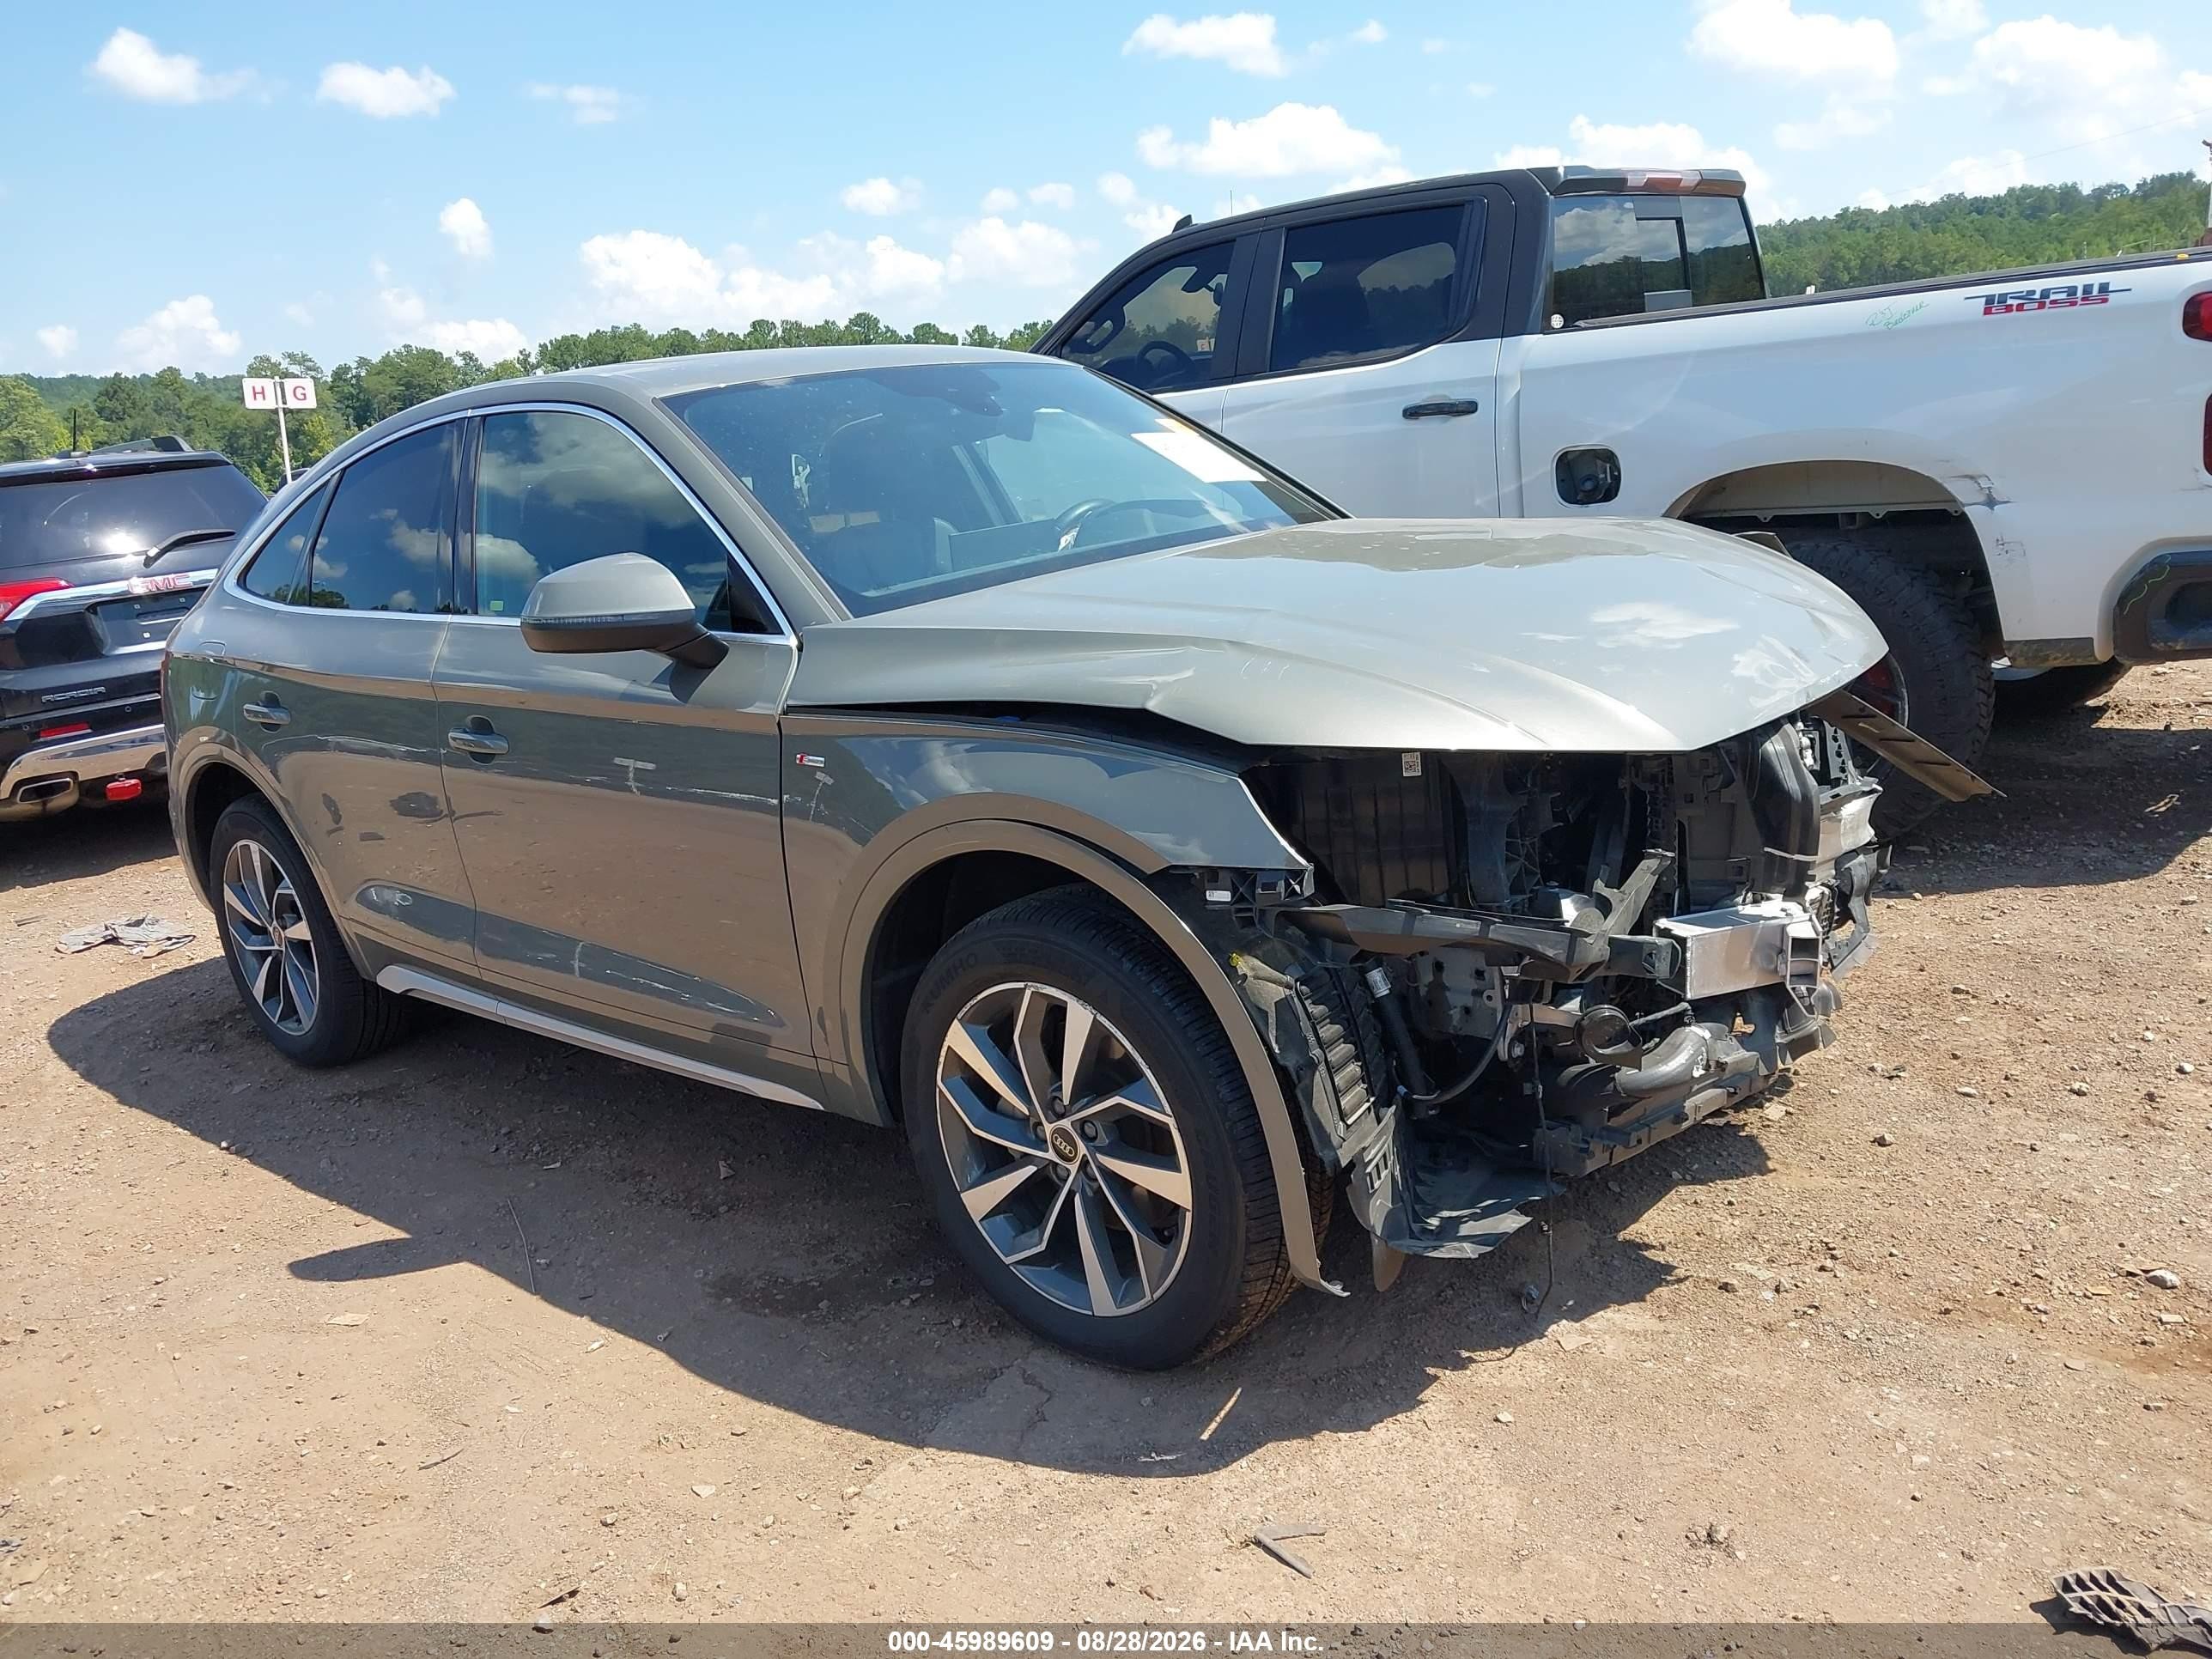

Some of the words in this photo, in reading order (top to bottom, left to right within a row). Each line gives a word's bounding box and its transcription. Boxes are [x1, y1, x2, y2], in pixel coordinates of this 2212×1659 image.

[1965, 282, 2131, 306] TRAIL
[1983, 295, 2110, 315] BOSS
[252, 386, 265, 401] H
[293, 386, 307, 401] G
[127, 574, 193, 594] GMC
[41, 686, 106, 703] ACADIA
